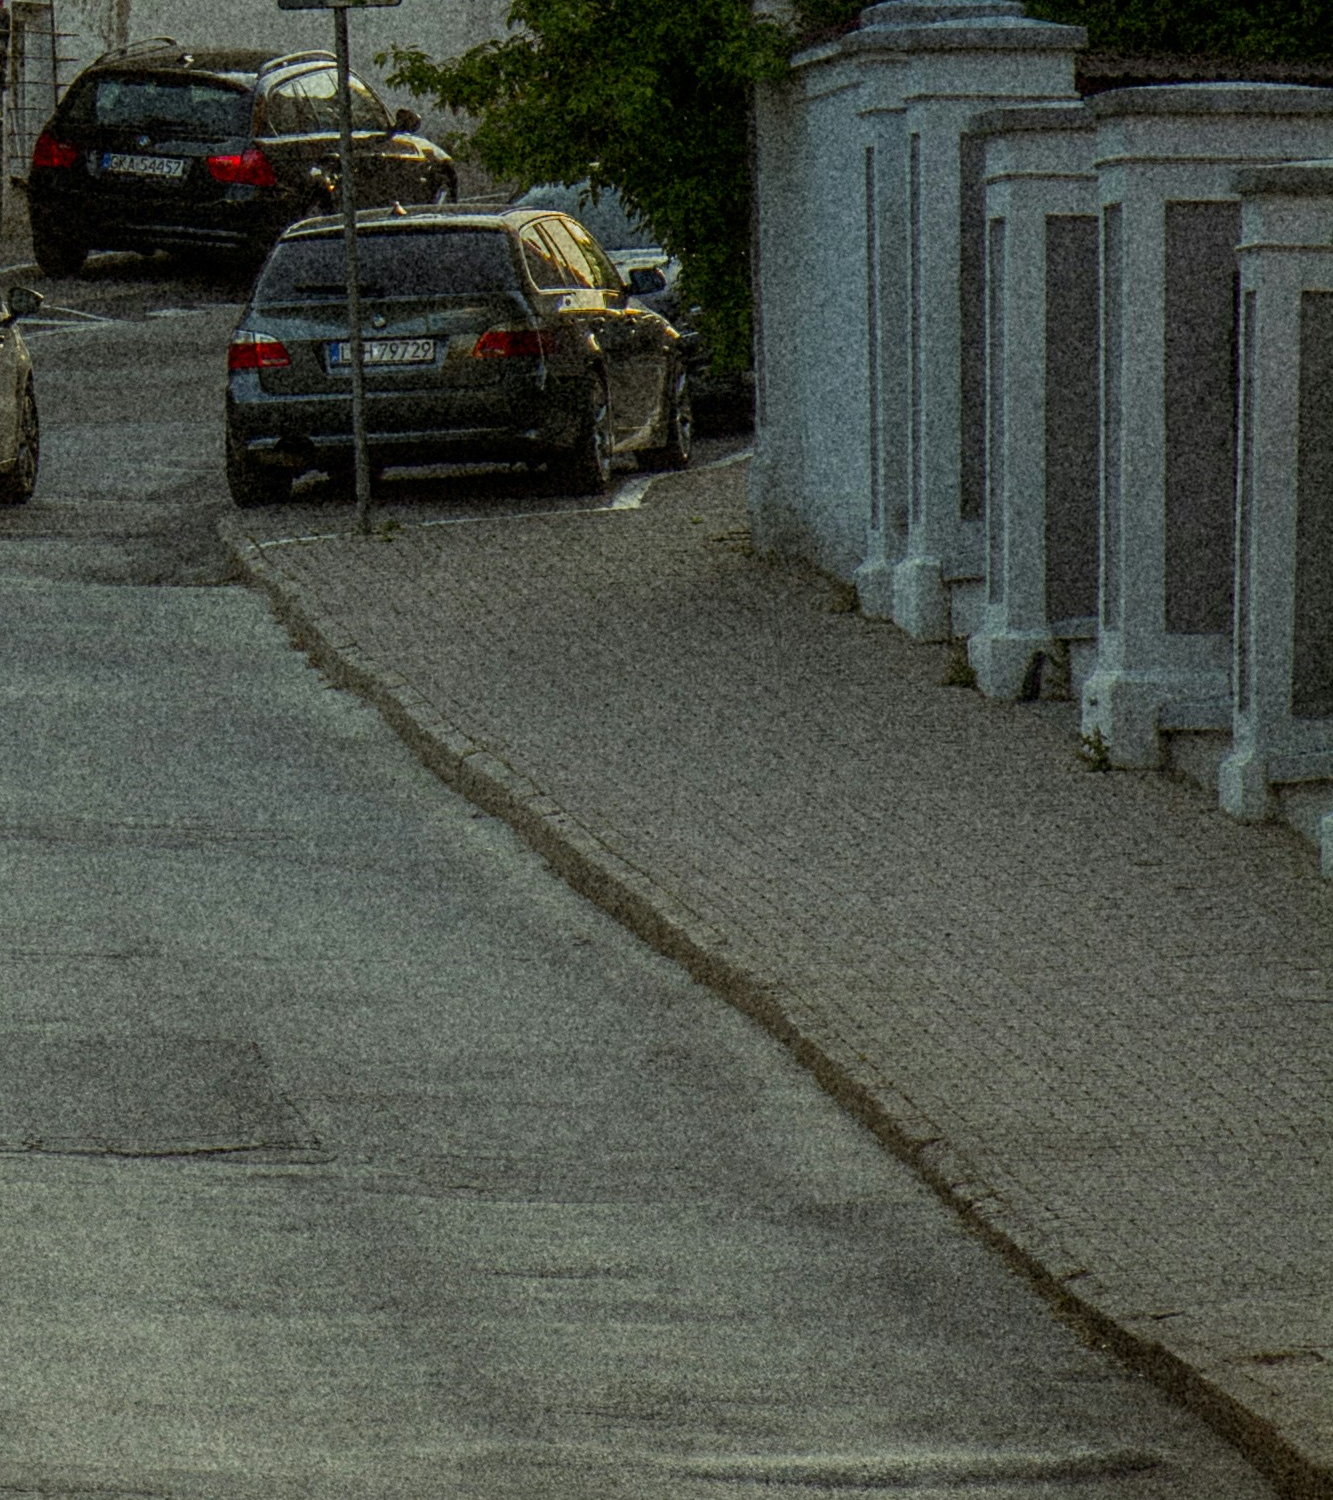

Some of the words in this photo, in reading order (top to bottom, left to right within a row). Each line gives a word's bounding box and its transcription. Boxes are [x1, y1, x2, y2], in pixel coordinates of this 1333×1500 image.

[111, 155, 134, 169] GKA
[139, 157, 181, 174] 54457
[341, 343, 373, 361] LH
[379, 341, 431, 359] 79729
